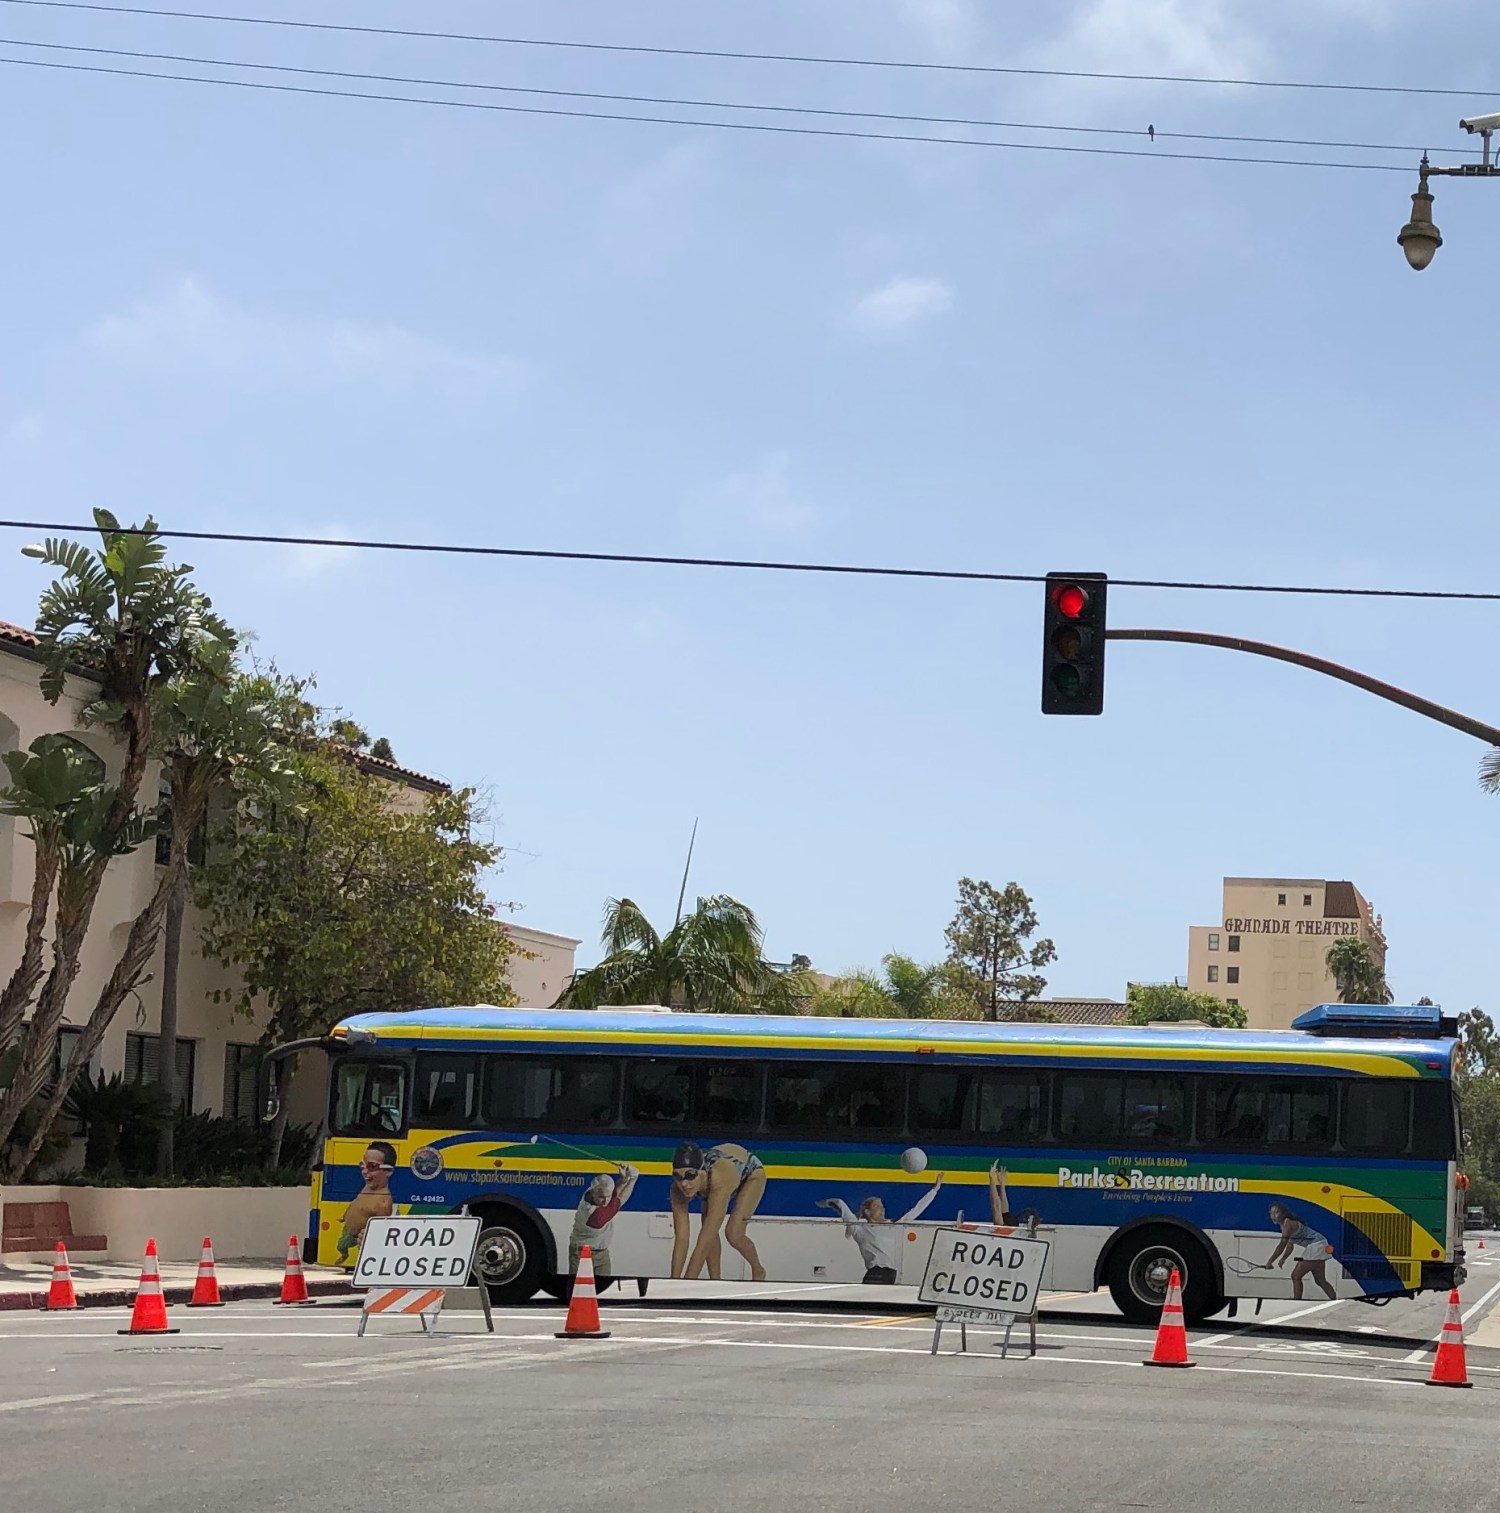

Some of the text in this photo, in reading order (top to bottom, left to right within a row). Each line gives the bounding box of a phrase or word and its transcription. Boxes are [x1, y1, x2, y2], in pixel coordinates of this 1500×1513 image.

[1224, 918, 1359, 936] GRANADA THEATRE
[1107, 1156, 1188, 1167] CITY OF SANTA BARBARA
[444, 1170, 585, 1187] www.sbparksandrecreation.com
[410, 1194, 421, 1202] CA
[1102, 1191, 1141, 1203] Enriching
[384, 1228, 455, 1247] ROAD
[951, 1241, 1024, 1269] ROAD
[361, 1257, 466, 1277] CLOSED
[932, 1272, 1028, 1302] CLOSED
